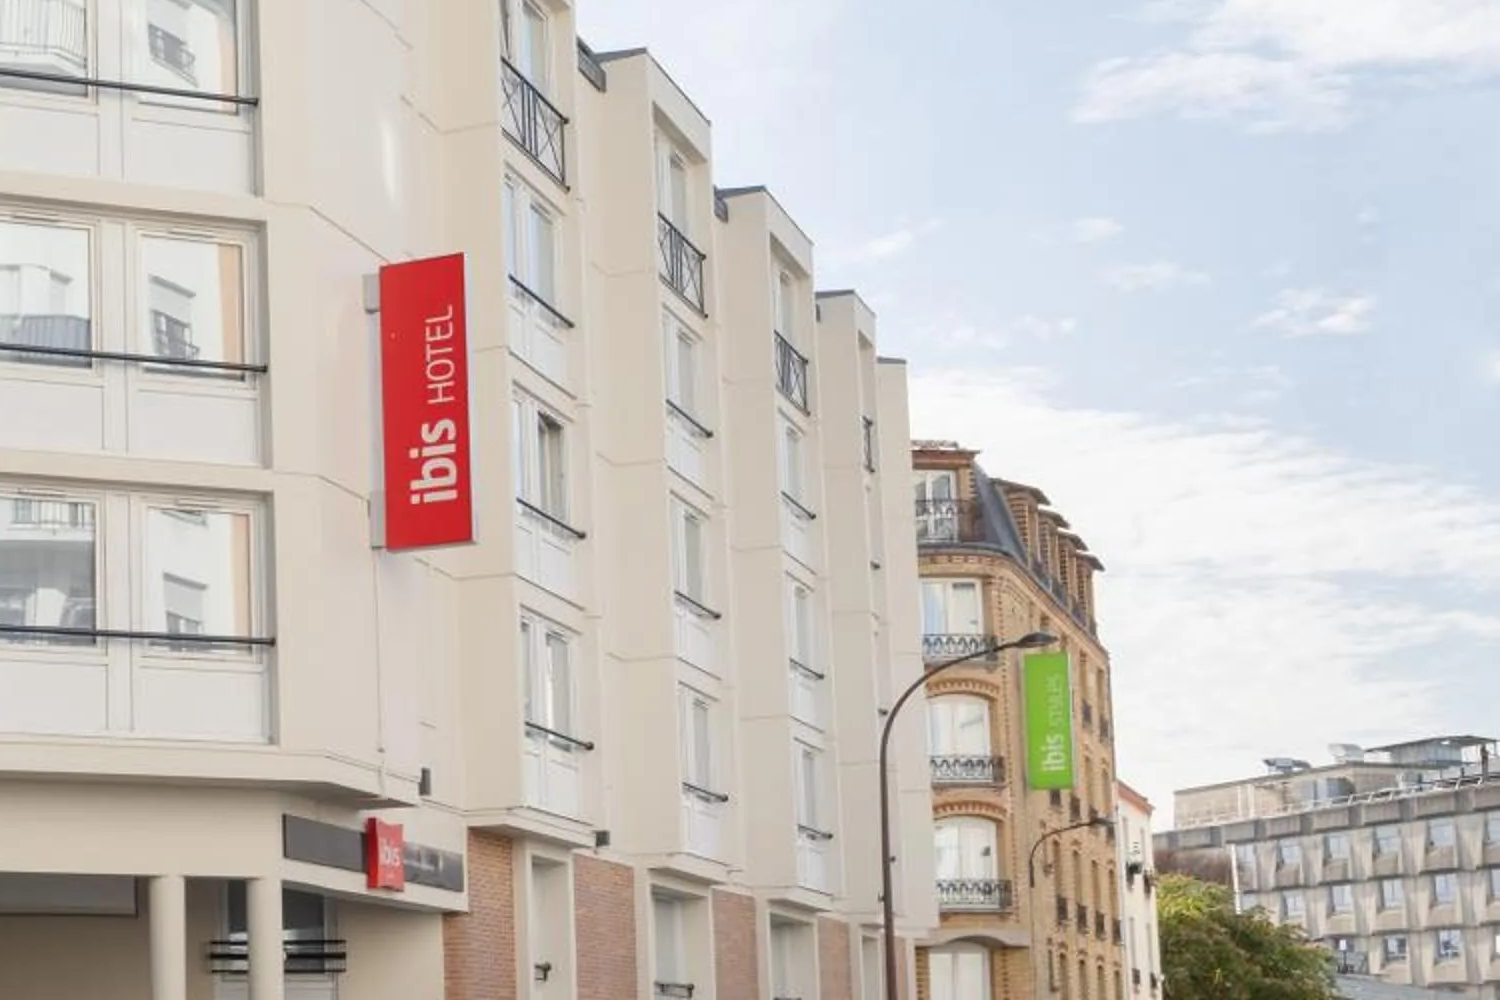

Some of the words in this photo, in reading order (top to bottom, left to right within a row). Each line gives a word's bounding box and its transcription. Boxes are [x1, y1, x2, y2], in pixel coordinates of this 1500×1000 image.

[425, 304, 455, 404] HOTEL
[409, 417, 458, 504] ibis
[1040, 733, 1066, 771] ibis
